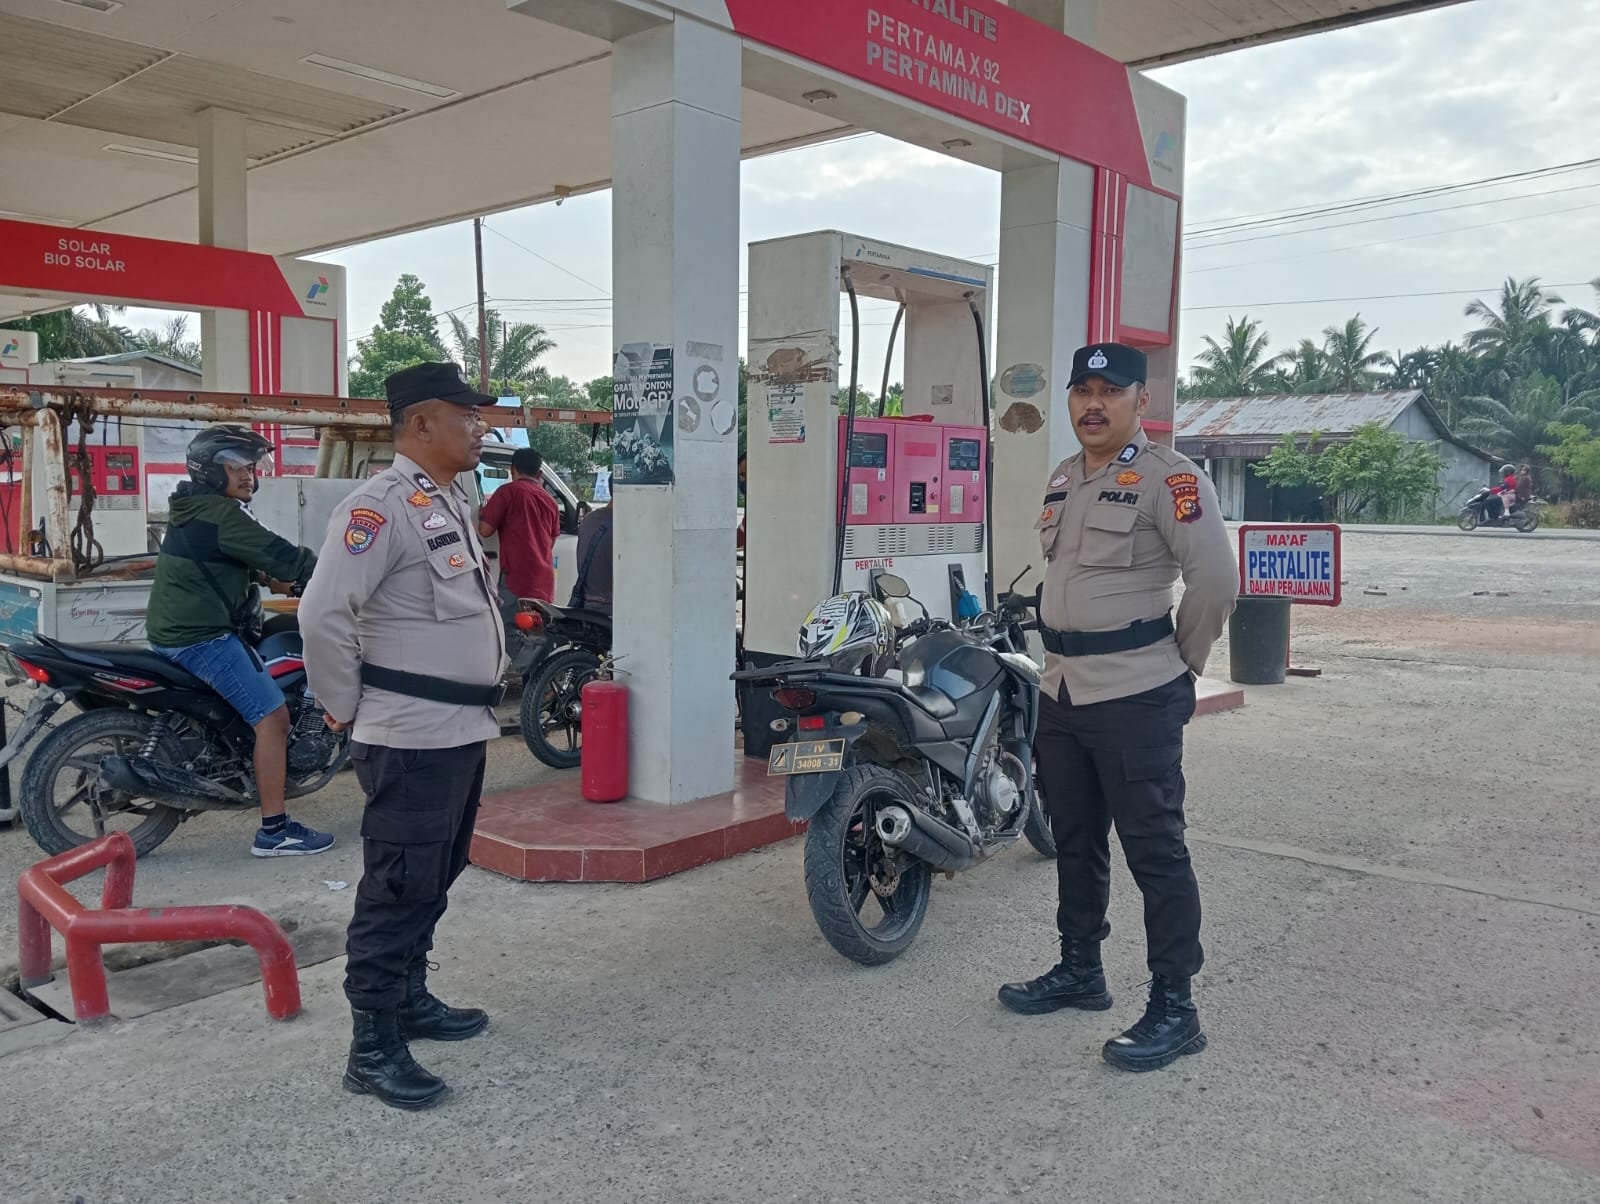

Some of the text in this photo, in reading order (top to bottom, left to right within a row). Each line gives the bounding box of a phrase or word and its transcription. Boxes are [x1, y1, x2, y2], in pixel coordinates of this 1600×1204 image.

[983, 58, 1001, 85] 92
[866, 41, 1031, 126] PERTAMINA DEX
[58, 238, 111, 255] SOLAR
[44, 252, 125, 273] BIO SOLAR
[613, 382, 639, 393] GRATI
[1098, 490, 1139, 505] POLRI
[1266, 534, 1309, 546] MA'AF
[855, 557, 894, 571] PERTALITE
[1248, 550, 1331, 580] PERTALITE
[1249, 580, 1331, 596] DALAM PERJALANAN
[813, 744, 825, 753] IV
